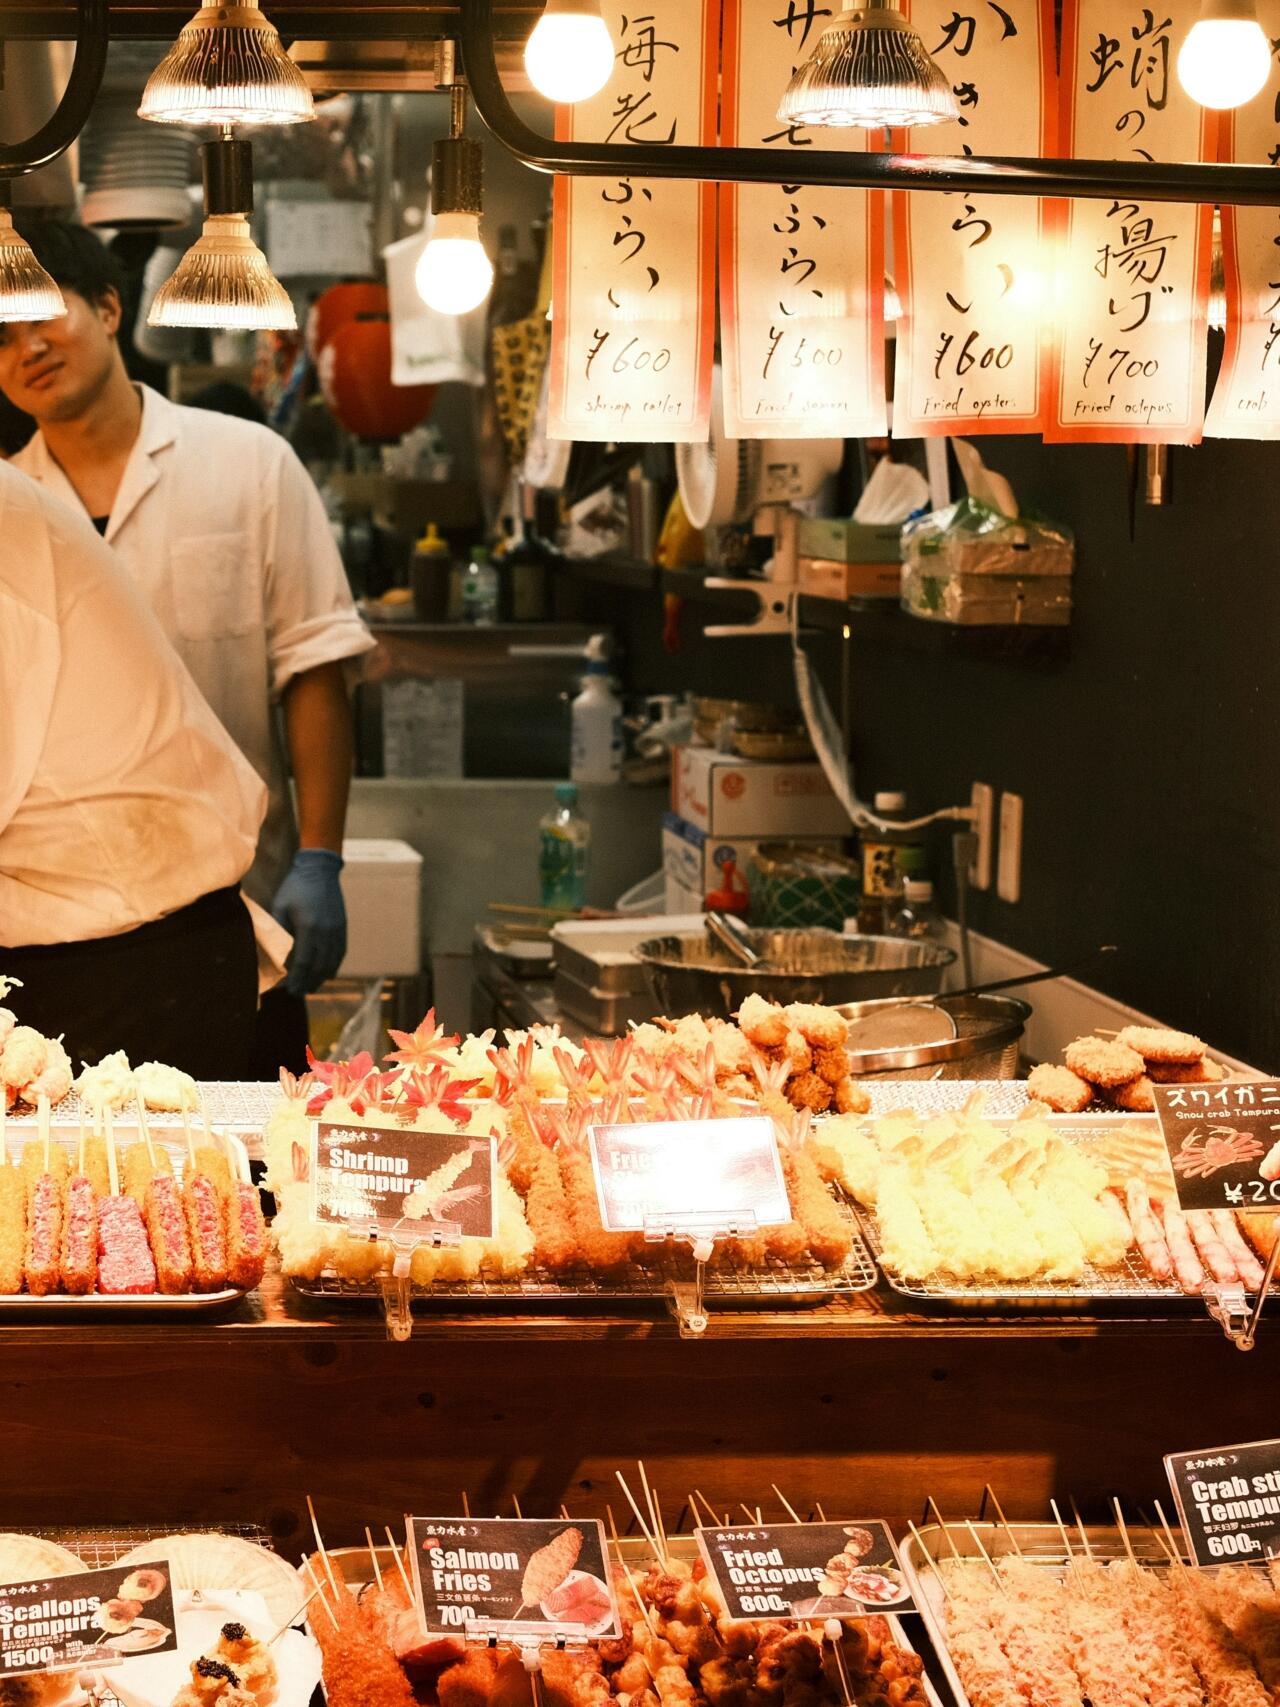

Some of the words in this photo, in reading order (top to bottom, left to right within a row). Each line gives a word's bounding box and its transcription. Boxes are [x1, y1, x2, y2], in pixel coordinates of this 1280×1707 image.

[934, 331, 1014, 380] ¥600
[1083, 338, 1160, 388] ¥700
[924, 387, 964, 415] Fried
[1074, 394, 1113, 417] Fried
[1124, 398, 1173, 425] octopus
[1166, 1085, 1280, 1107] ズワイガニ
[1175, 1110, 1204, 1120] Snow
[1207, 1108, 1231, 1118] crab
[1234, 1107, 1280, 1117] Tempura
[329, 1148, 409, 1175] Shrimp
[331, 1167, 426, 1194] Tempura
[1191, 1476, 1250, 1502] Crab
[1207, 1533, 1262, 1557] 600円
[429, 1547, 520, 1571] Salmon
[722, 1548, 784, 1568] Fried
[432, 1570, 492, 1592] Fries
[728, 1565, 827, 1585] Octopus
[0, 1596, 101, 1624] Scallops
[739, 1594, 793, 1613] 800円
[0, 1616, 101, 1641] Tempura
